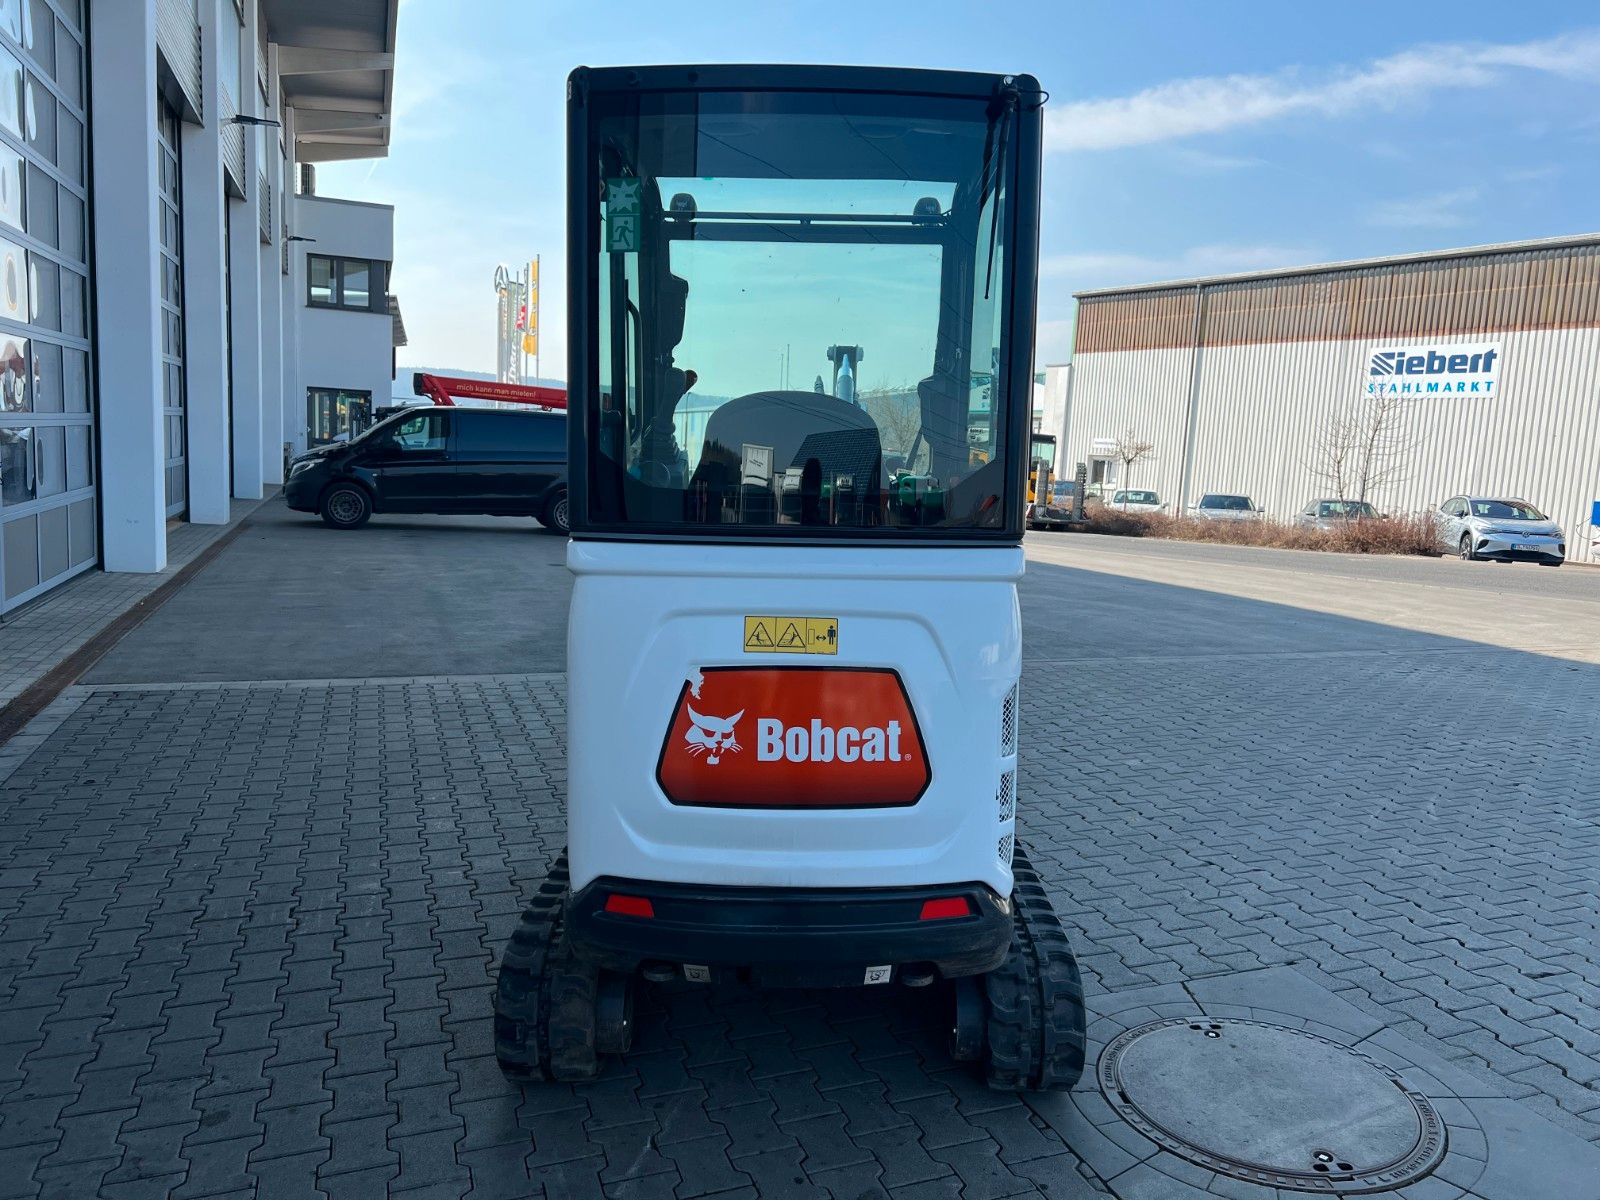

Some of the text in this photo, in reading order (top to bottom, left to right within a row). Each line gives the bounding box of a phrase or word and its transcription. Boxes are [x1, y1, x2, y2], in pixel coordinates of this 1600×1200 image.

[1370, 348, 1498, 376] Siebert
[456, 384, 474, 392] mich
[475, 385, 493, 393] kann
[494, 387, 510, 396] man
[510, 389, 536, 398] mieten!
[1367, 381, 1494, 394] STAHLMARKT
[757, 718, 902, 763] Bobcat
